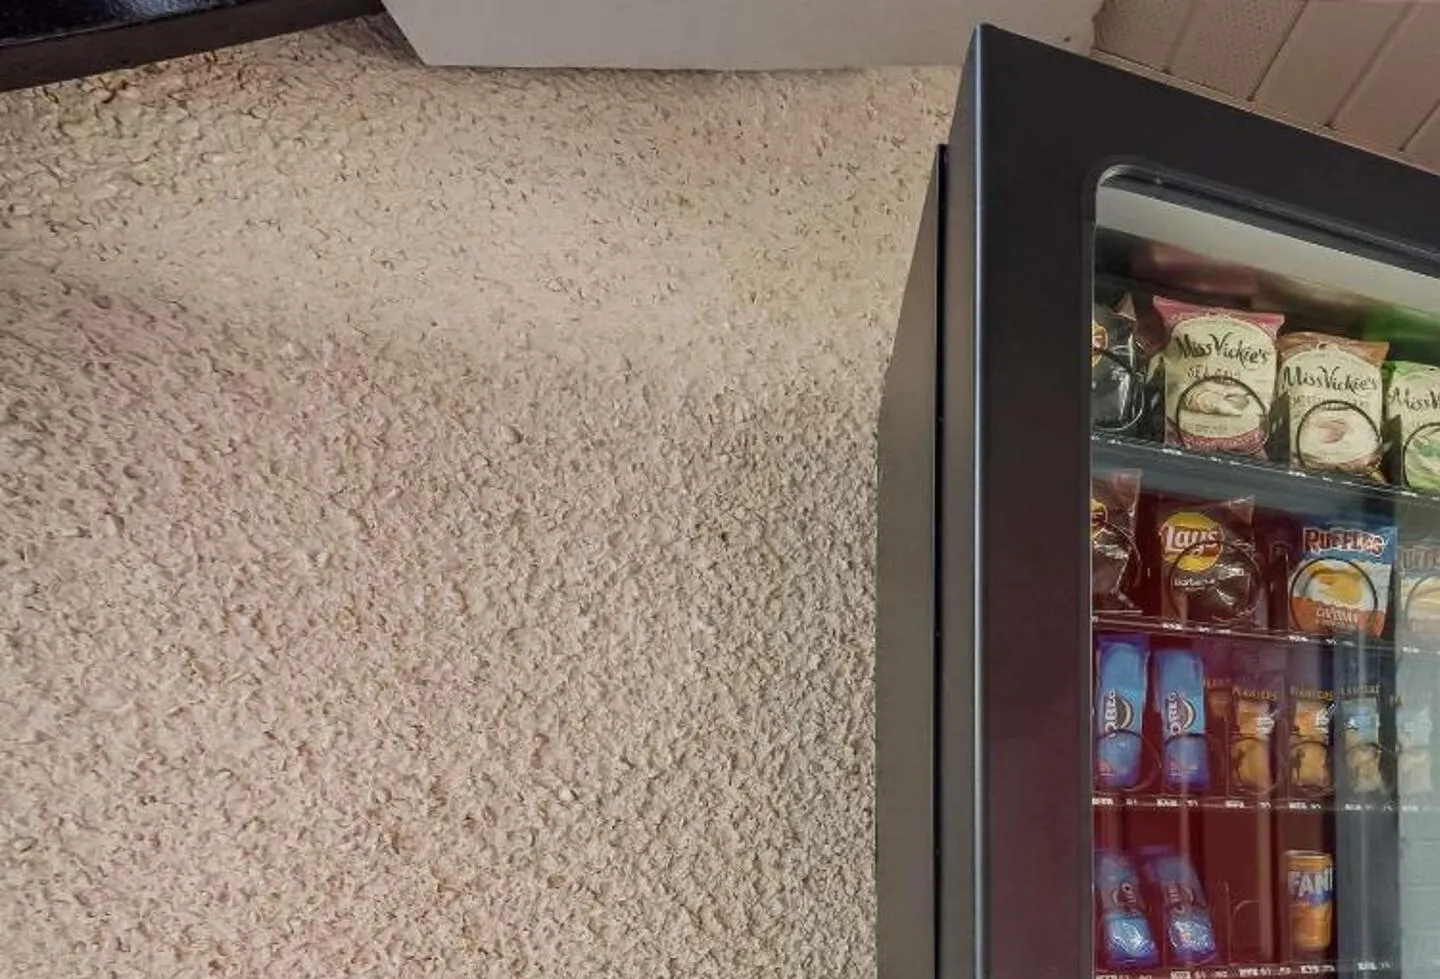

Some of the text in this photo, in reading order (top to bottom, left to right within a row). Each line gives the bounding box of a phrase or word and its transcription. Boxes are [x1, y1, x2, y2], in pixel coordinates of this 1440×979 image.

[1175, 331, 1269, 368] Miss Vickie's
[1281, 366, 1377, 394] Miss Vickie's
[1387, 386, 1432, 412] Miss
